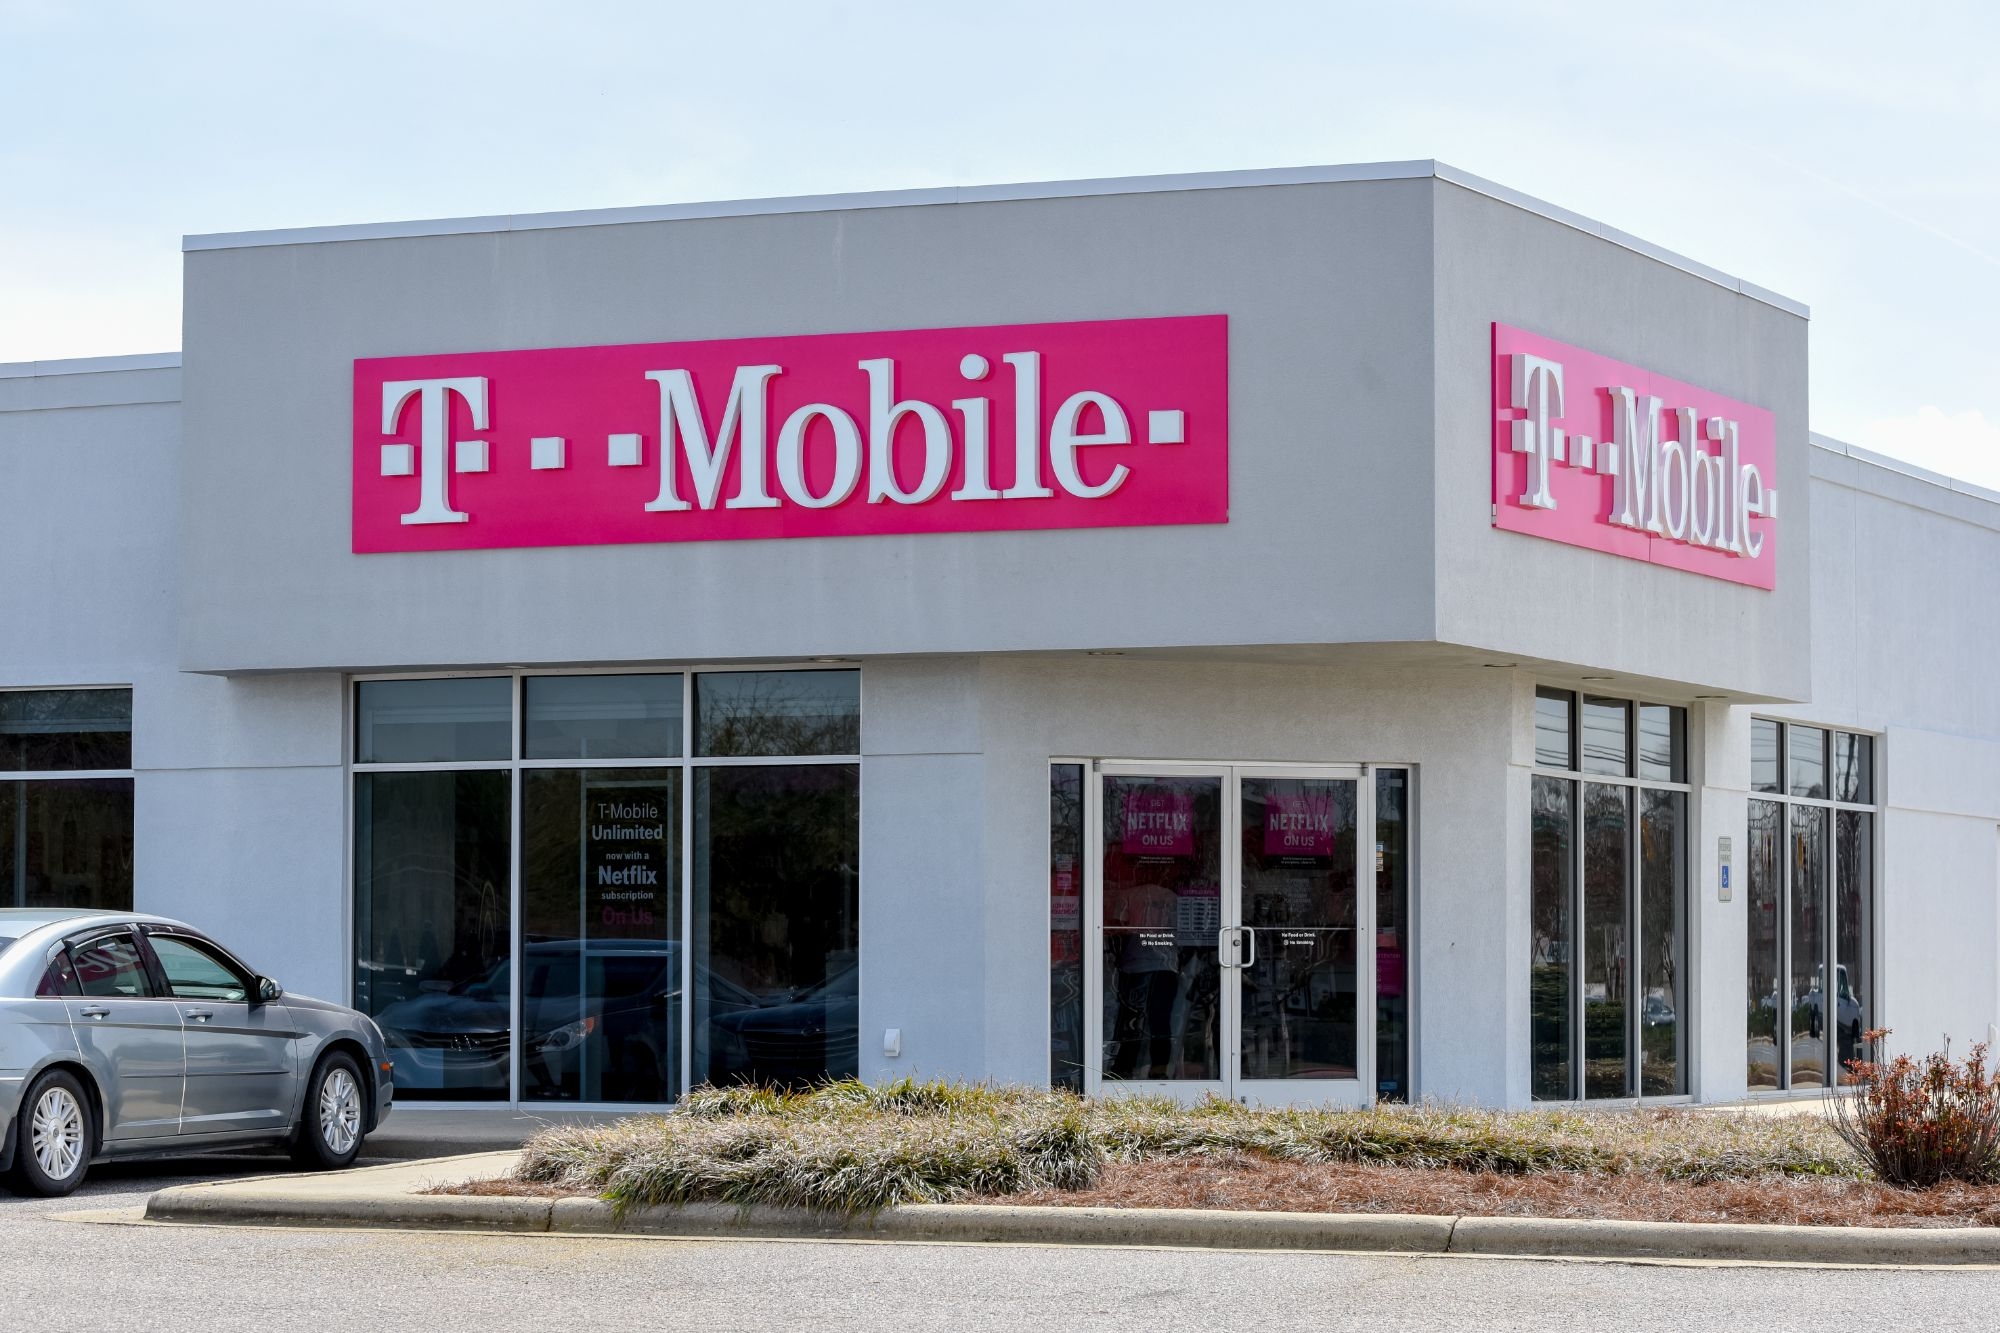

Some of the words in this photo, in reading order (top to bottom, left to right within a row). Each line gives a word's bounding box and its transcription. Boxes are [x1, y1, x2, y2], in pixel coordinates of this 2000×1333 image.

[598, 803, 658, 819] T-Mobile
[1128, 812, 1188, 832] NETFLIX
[1269, 813, 1329, 833] NETFLIX
[592, 824, 663, 840] Unlimited
[1142, 835, 1158, 846] ON
[1160, 835, 1174, 846] US
[1284, 835, 1299, 846] ON
[1300, 835, 1315, 846] US
[605, 852, 623, 860] now
[624, 850, 642, 860] with
[644, 852, 650, 860] a
[598, 865, 658, 885] Netflix
[601, 890, 654, 901] subscription
[602, 905, 626, 925] On
[631, 905, 654, 925] Us
